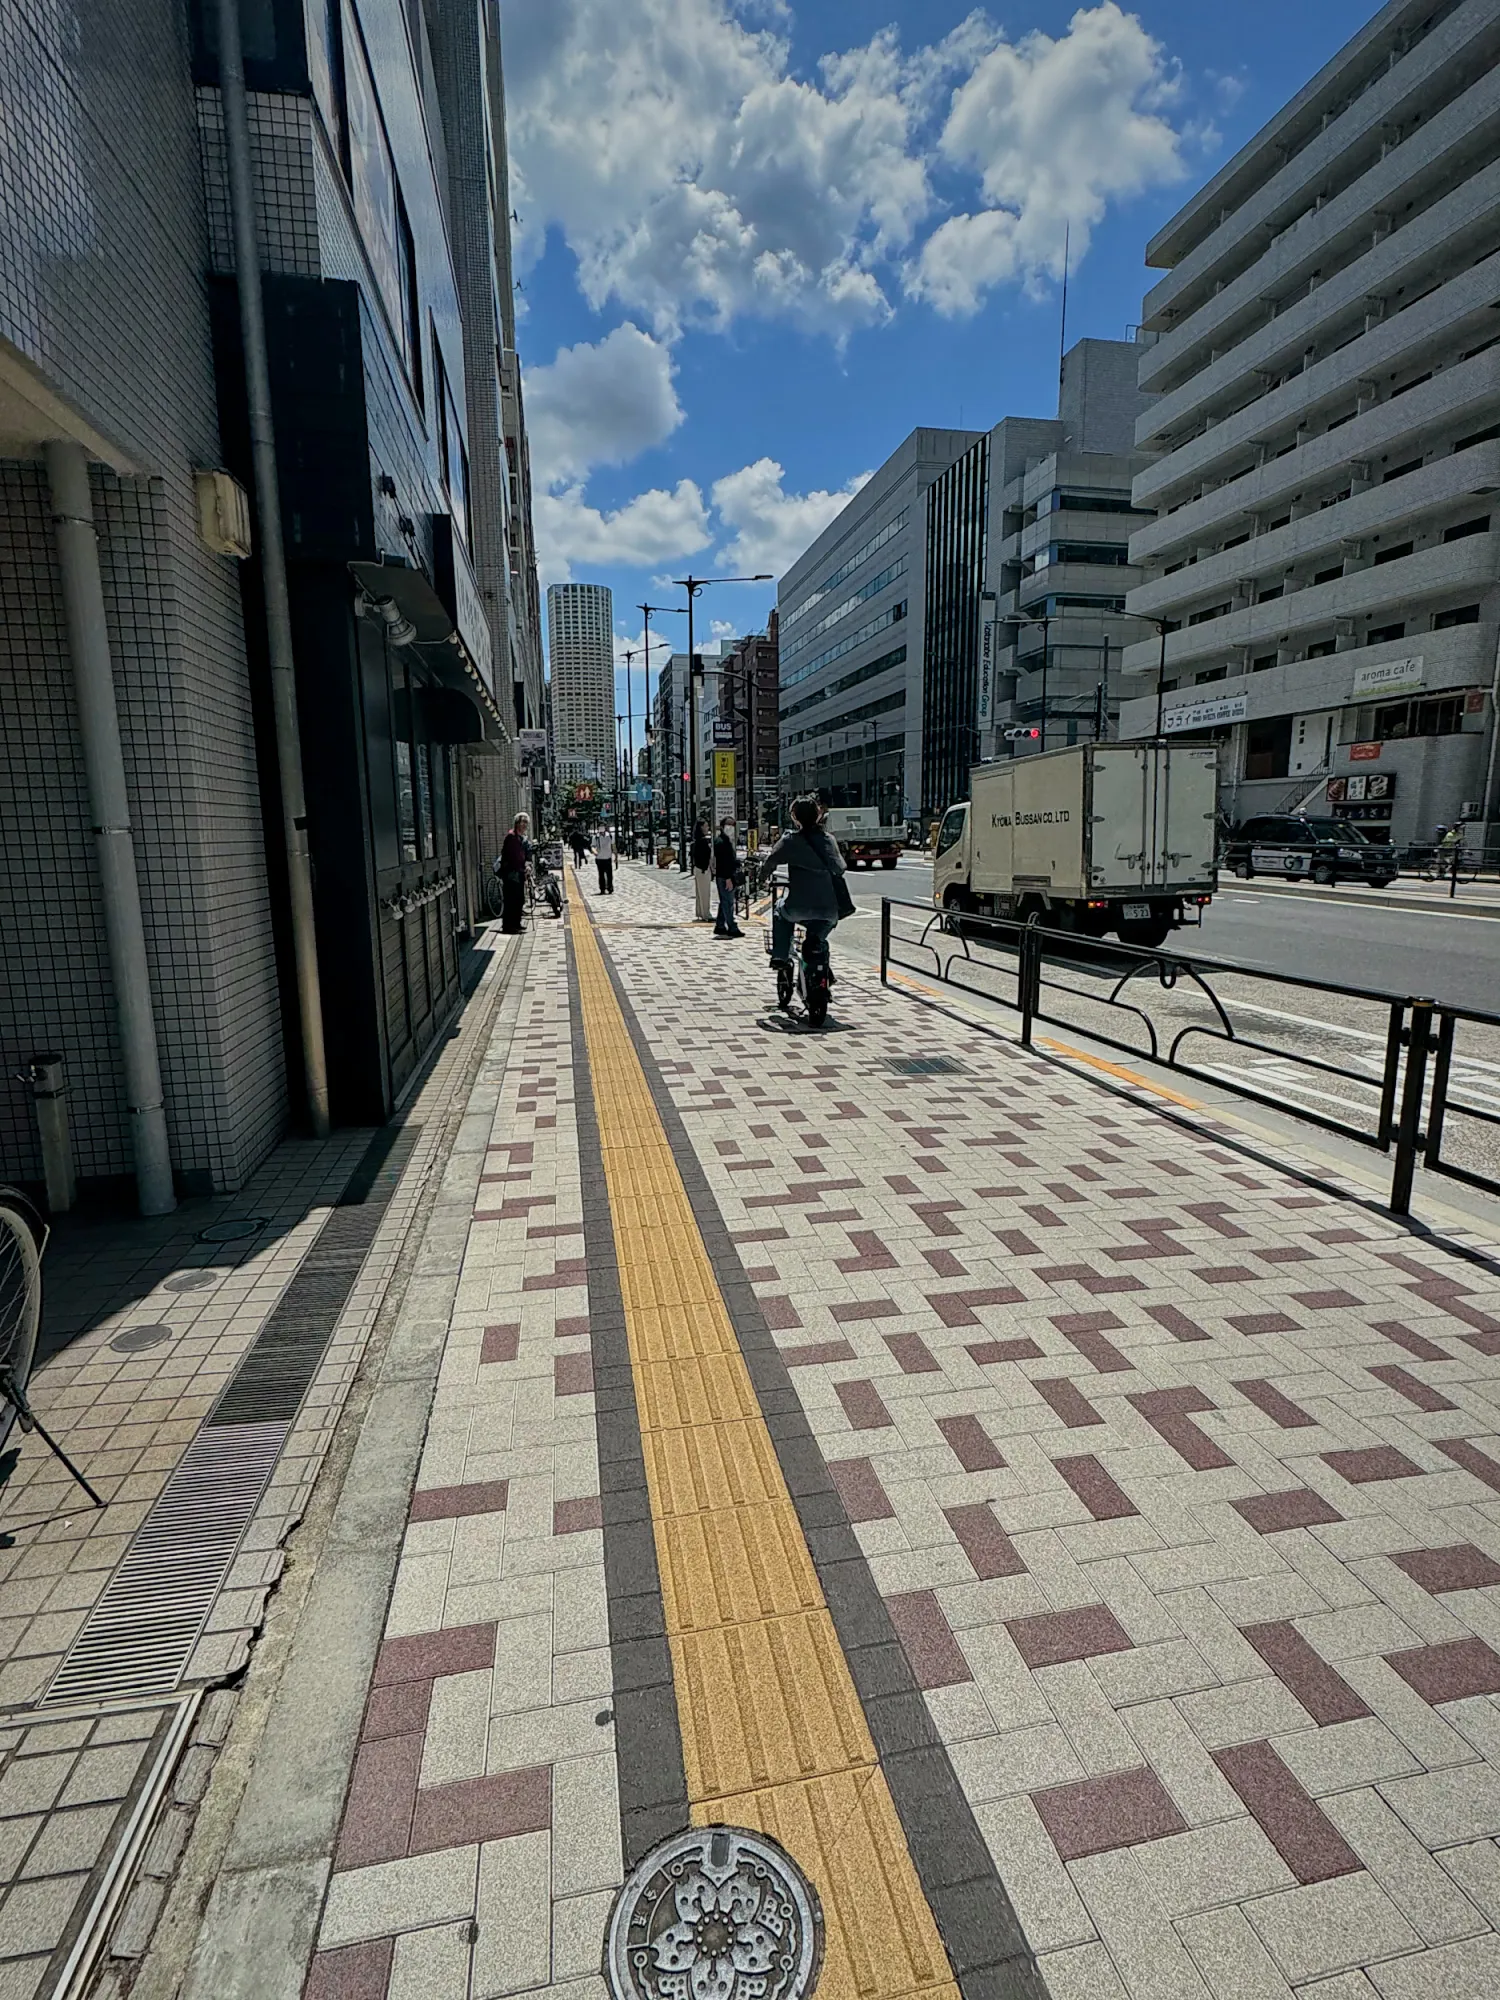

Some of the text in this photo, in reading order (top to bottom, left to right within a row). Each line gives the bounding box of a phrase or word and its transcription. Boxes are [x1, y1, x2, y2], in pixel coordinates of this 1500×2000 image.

[983, 660, 991, 693] Education
[1361, 669, 1391, 681] aroma
[980, 695, 990, 717] Group
[715, 723, 732, 731] BUS
[1015, 811, 1042, 826] BUSSAN
